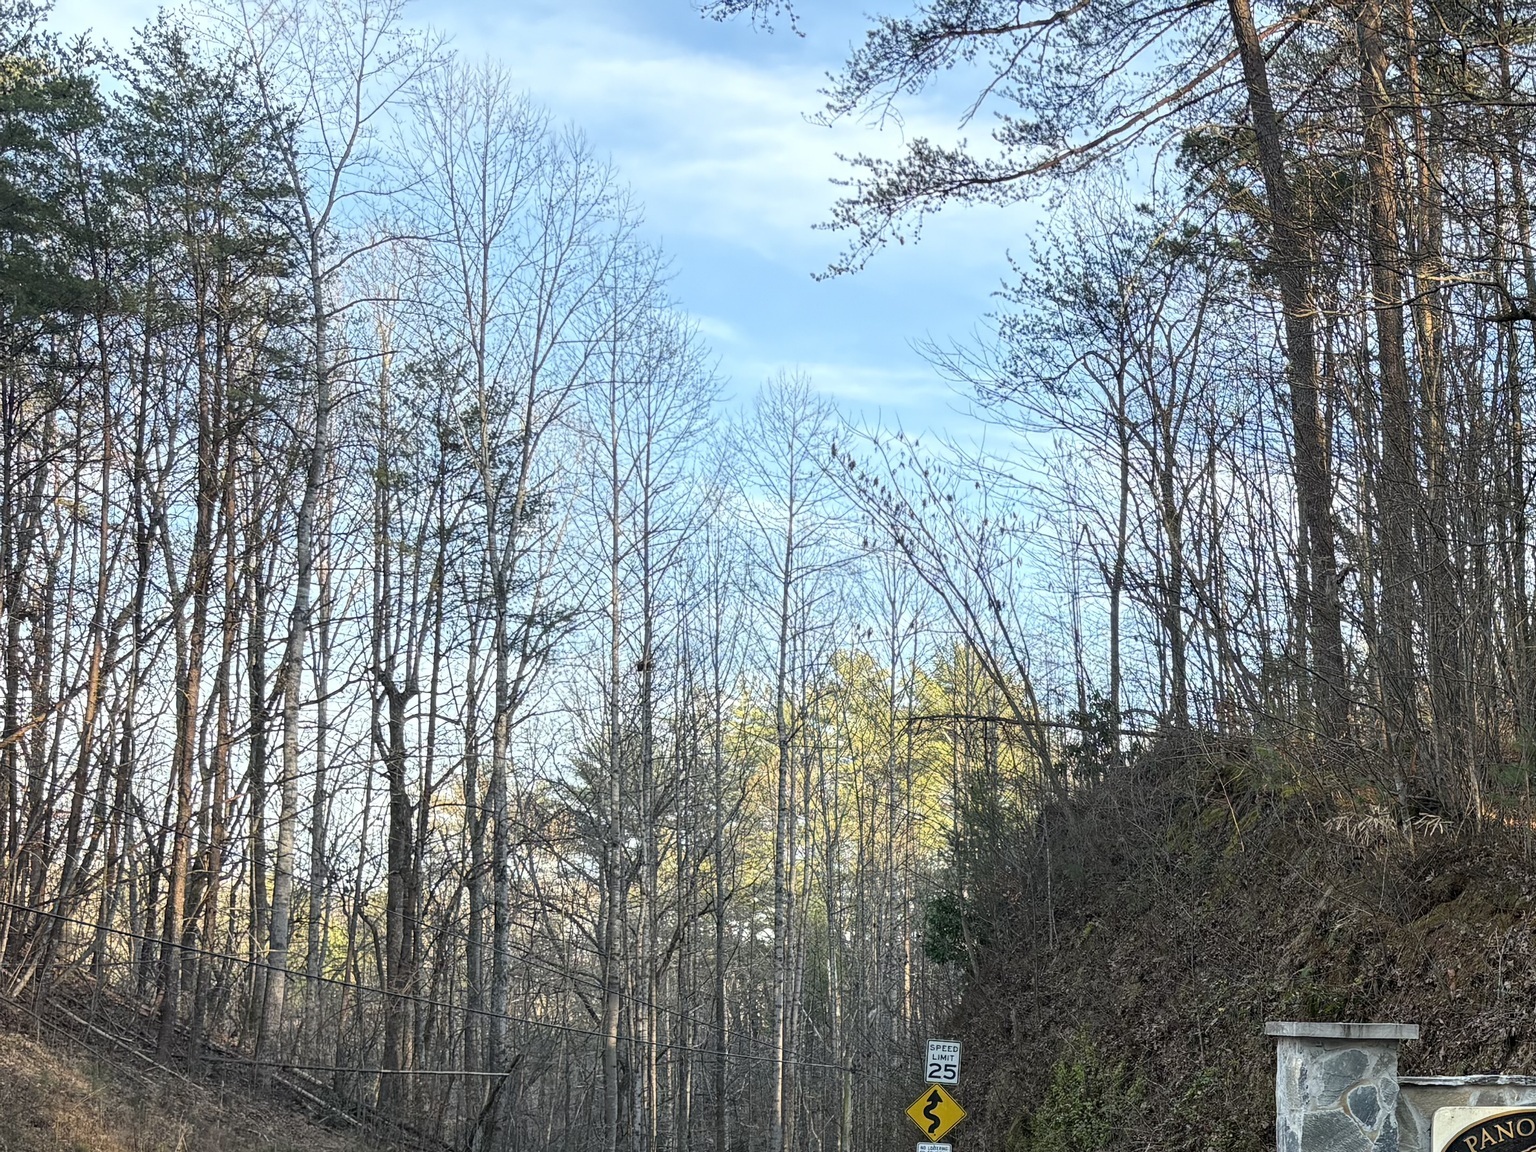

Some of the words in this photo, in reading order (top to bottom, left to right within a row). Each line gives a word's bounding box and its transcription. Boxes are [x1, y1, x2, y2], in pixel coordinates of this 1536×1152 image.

[930, 1044, 959, 1053] SPEED
[932, 1053, 955, 1061] LIMIT
[928, 1063, 957, 1080] 25
